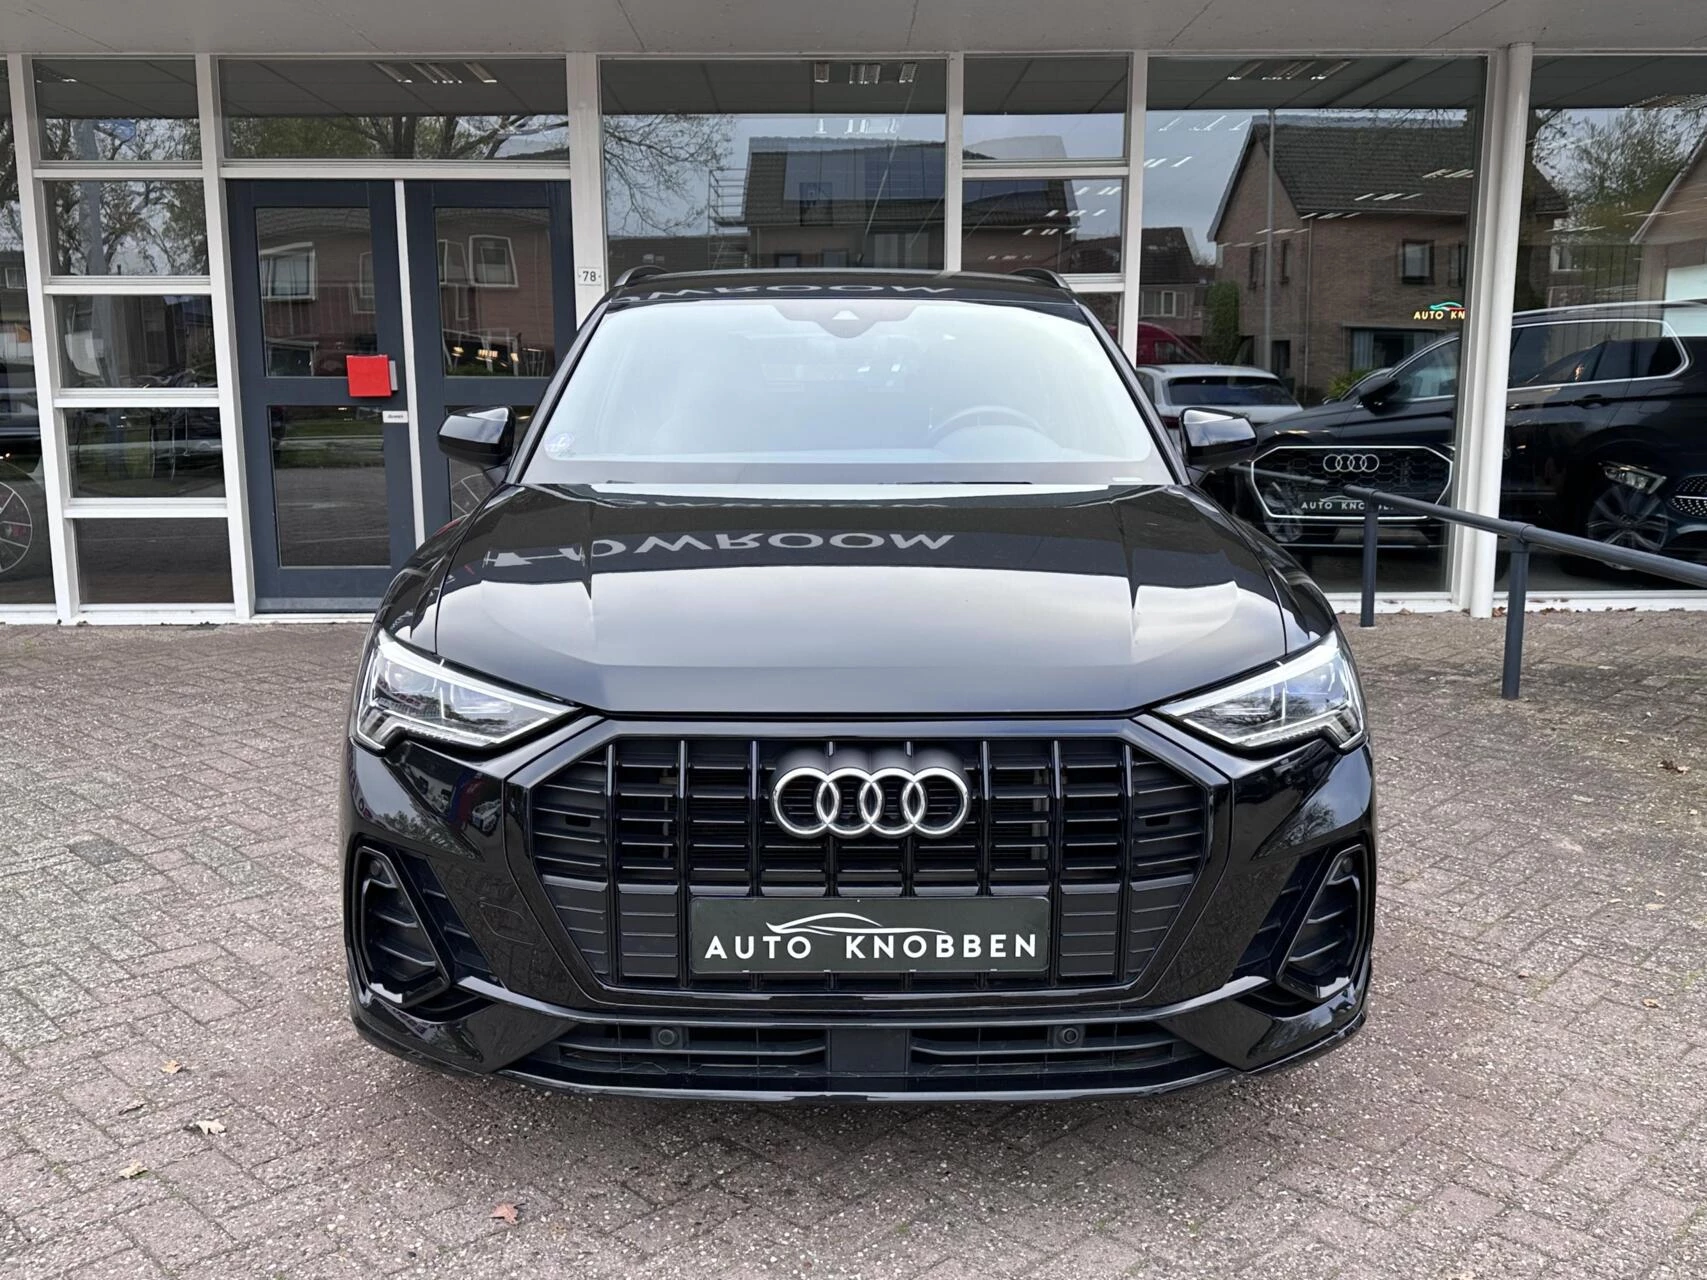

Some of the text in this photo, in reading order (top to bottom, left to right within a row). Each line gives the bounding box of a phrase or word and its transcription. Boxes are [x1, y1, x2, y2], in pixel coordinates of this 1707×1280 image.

[582, 270, 597, 282] 78
[1413, 310, 1444, 320] AUTO
[1301, 501, 1333, 510] AUTO
[704, 933, 1037, 959] AUTO KNOBBEN
